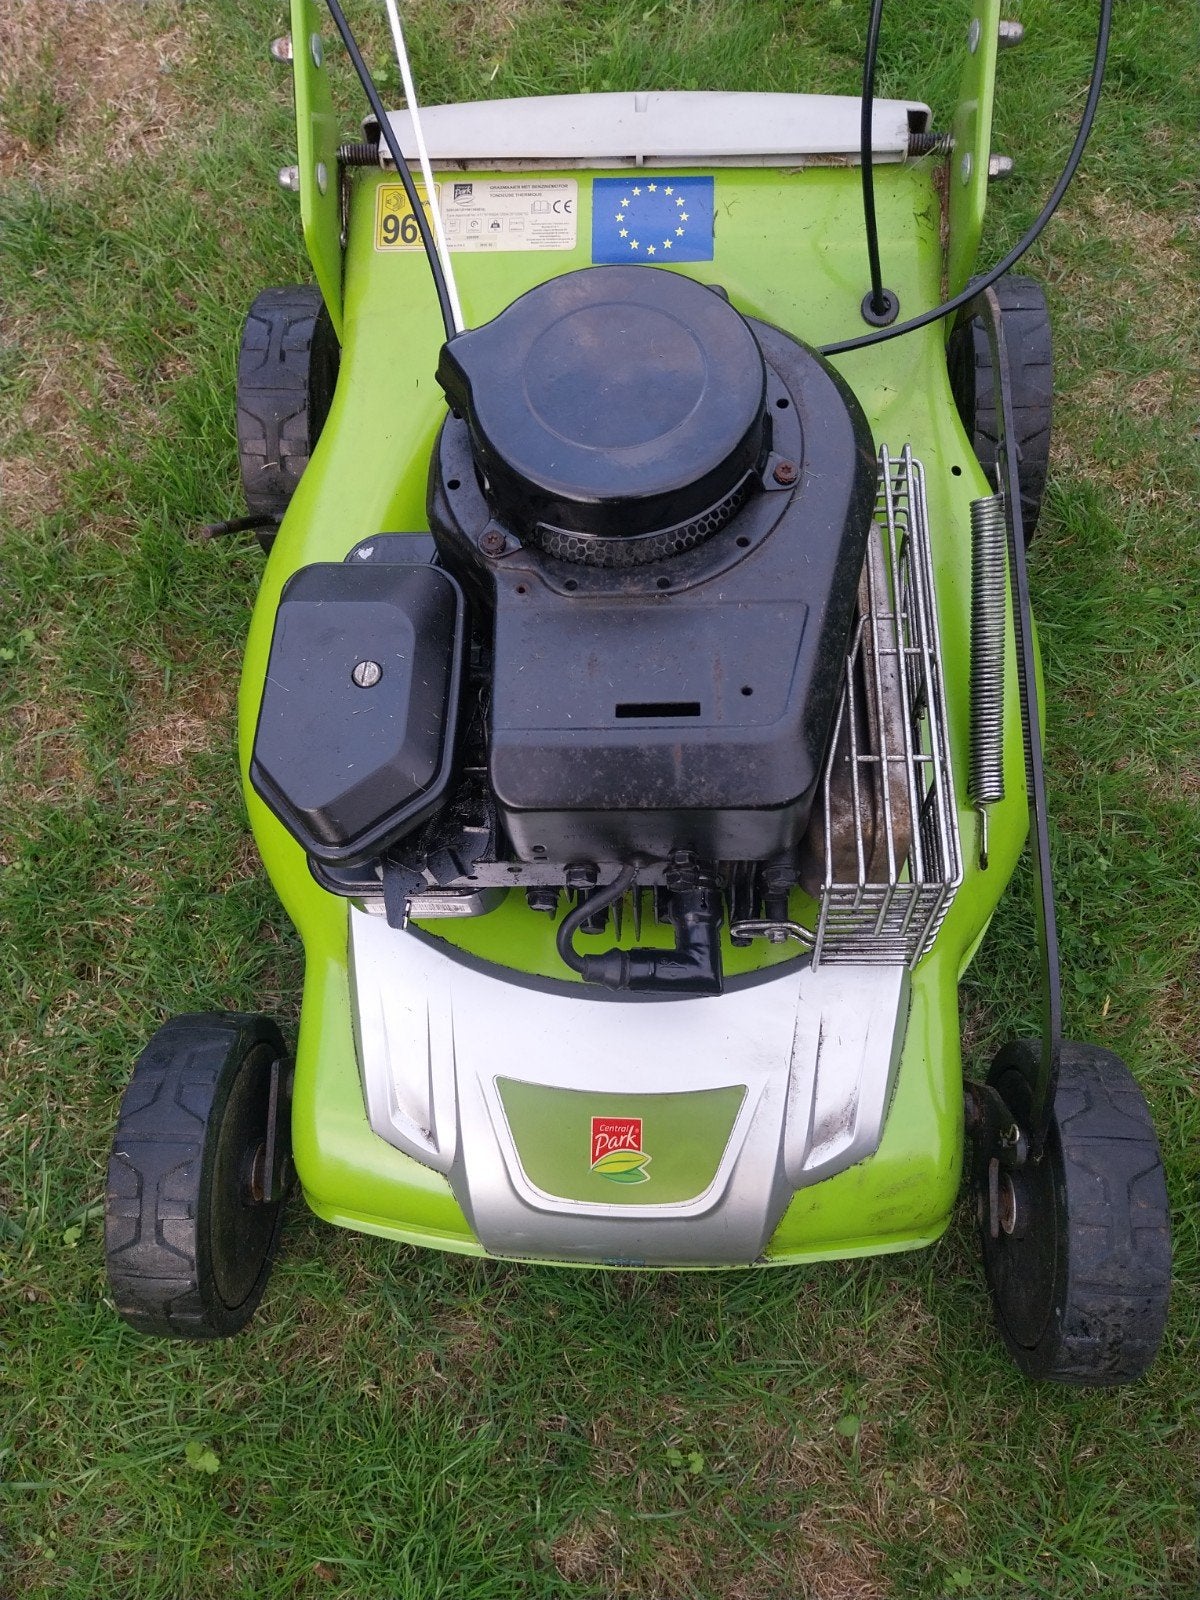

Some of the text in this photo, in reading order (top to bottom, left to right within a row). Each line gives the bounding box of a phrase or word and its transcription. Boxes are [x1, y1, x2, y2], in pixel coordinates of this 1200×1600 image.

[383, 214, 418, 244] 96
[595, 1125, 638, 1157] Park
[599, 1124, 629, 1132] Central
